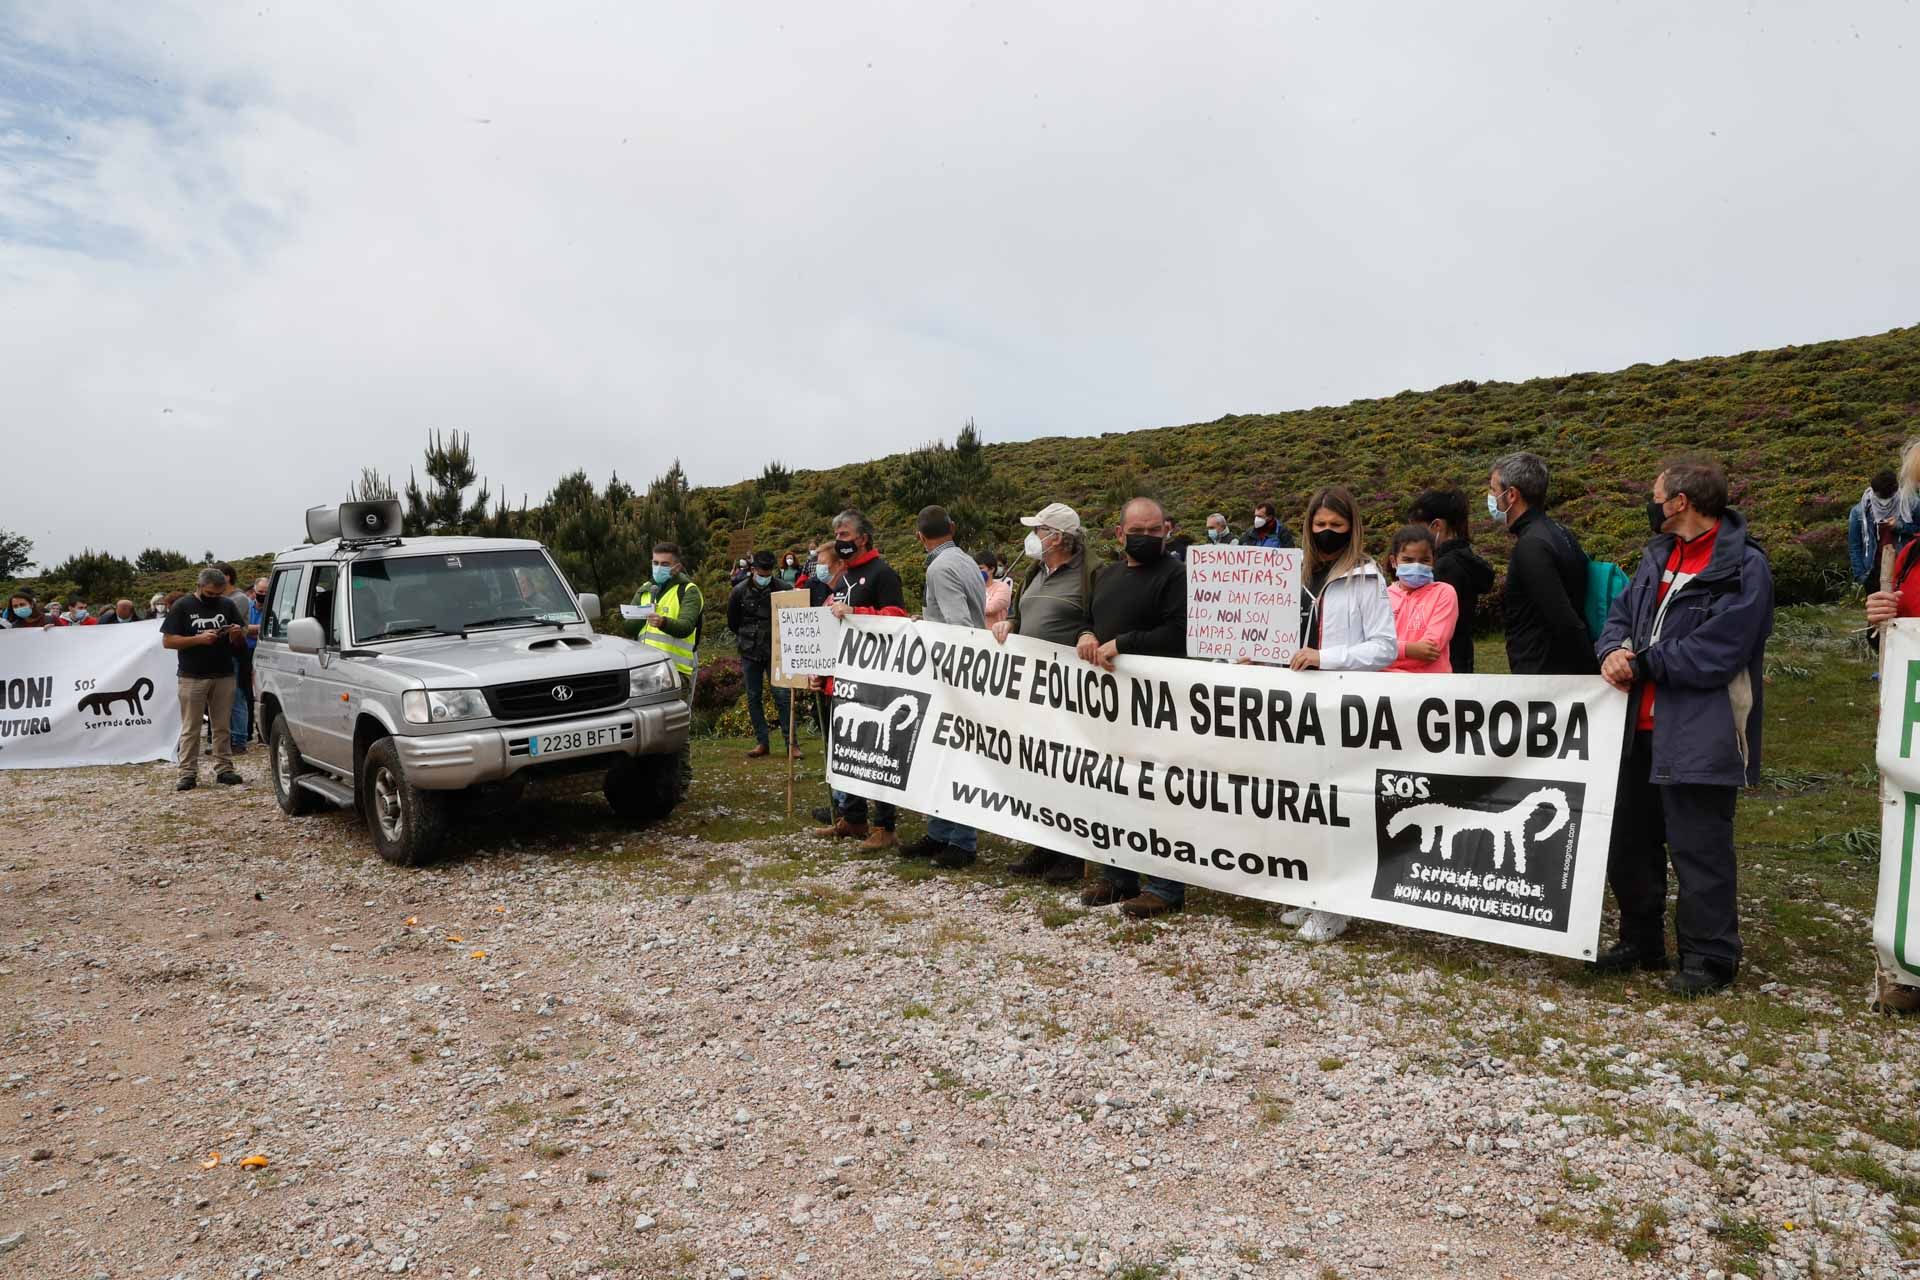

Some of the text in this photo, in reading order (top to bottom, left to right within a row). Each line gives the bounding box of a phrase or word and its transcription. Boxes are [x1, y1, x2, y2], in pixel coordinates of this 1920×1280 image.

[1192, 549, 1293, 571] DESMONTEMOS
[1191, 569, 1287, 588] AS MENTIRAS,
[1228, 590, 1250, 605] DAN
[1254, 592, 1297, 606] TRABA-
[781, 611, 819, 624] SALVEMOS
[1217, 609, 1241, 623] NON
[1245, 610, 1270, 624] SON
[788, 626, 821, 638] A GROBA
[1242, 628, 1268, 642] NON
[1272, 629, 1298, 644] SON
[1199, 641, 1231, 656] PARA
[1254, 643, 1290, 659] POBO
[74, 678, 97, 692] SOS
[833, 681, 858, 699] SOS
[838, 628, 894, 673] NON
[892, 634, 927, 676] AO
[930, 641, 1026, 700] PARQUE
[1131, 677, 1178, 731] NA
[1189, 682, 1326, 746] SERRA
[1340, 694, 1402, 751] DA
[1417, 697, 1590, 760] GROBA
[125, 718, 152, 726] Groba
[543, 727, 617, 752] 2238 BFT
[932, 712, 1012, 765] ESPAZO
[1019, 734, 1129, 796] NATURAL
[1138, 760, 1155, 801] E
[1164, 765, 1351, 828] CULTURAL
[1381, 773, 1430, 799] SOS
[952, 780, 1309, 882] www.sosgroba.com
[1561, 823, 1576, 890] www.sosgroba.com
[1410, 863, 1456, 884] Serra
[1482, 874, 1543, 898] Groba
[1393, 883, 1422, 901] NON
[1423, 890, 1441, 904] AO
[1444, 893, 1499, 914] PARQUE
